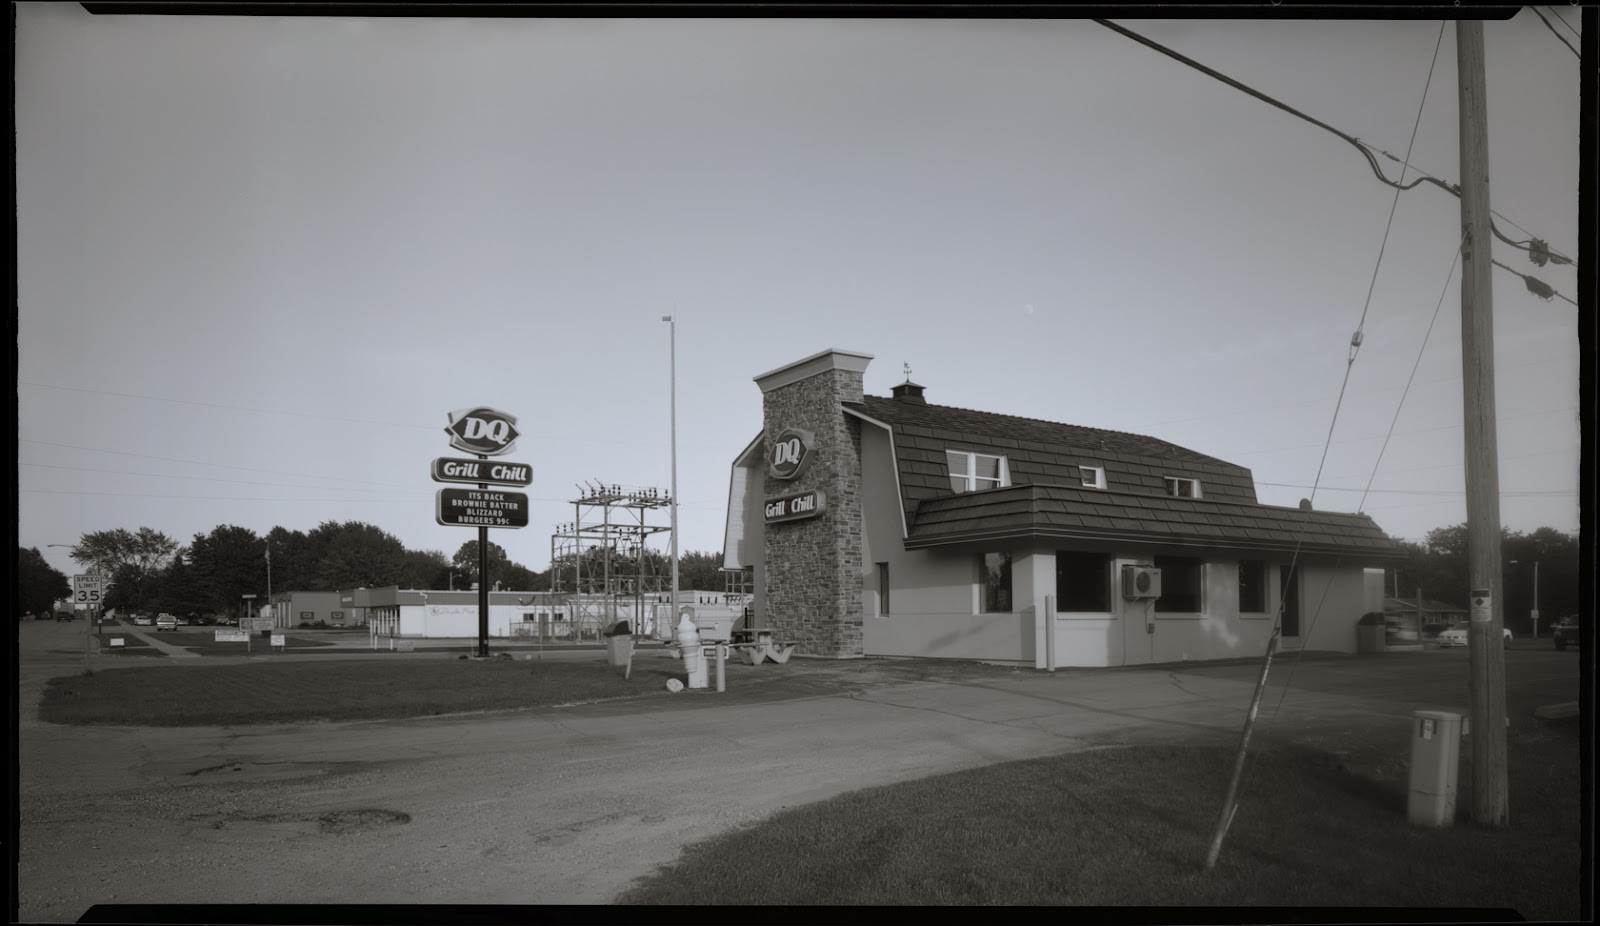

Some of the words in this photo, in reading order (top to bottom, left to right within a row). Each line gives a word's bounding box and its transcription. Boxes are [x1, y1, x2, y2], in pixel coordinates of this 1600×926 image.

[463, 417, 509, 445] DQ
[774, 438, 800, 466] DQ
[443, 462, 479, 478] Grill
[491, 465, 527, 481] Chill
[468, 492, 481, 500] ITS
[484, 493, 504, 501] BACK
[452, 500, 487, 508] BROWNIE
[489, 501, 518, 509] BATTER
[765, 500, 785, 518] Grill
[791, 495, 814, 513] Chill
[467, 508, 503, 517] BLIZZARD
[458, 516, 494, 524] BURGERS
[78, 590, 100, 601] 35
